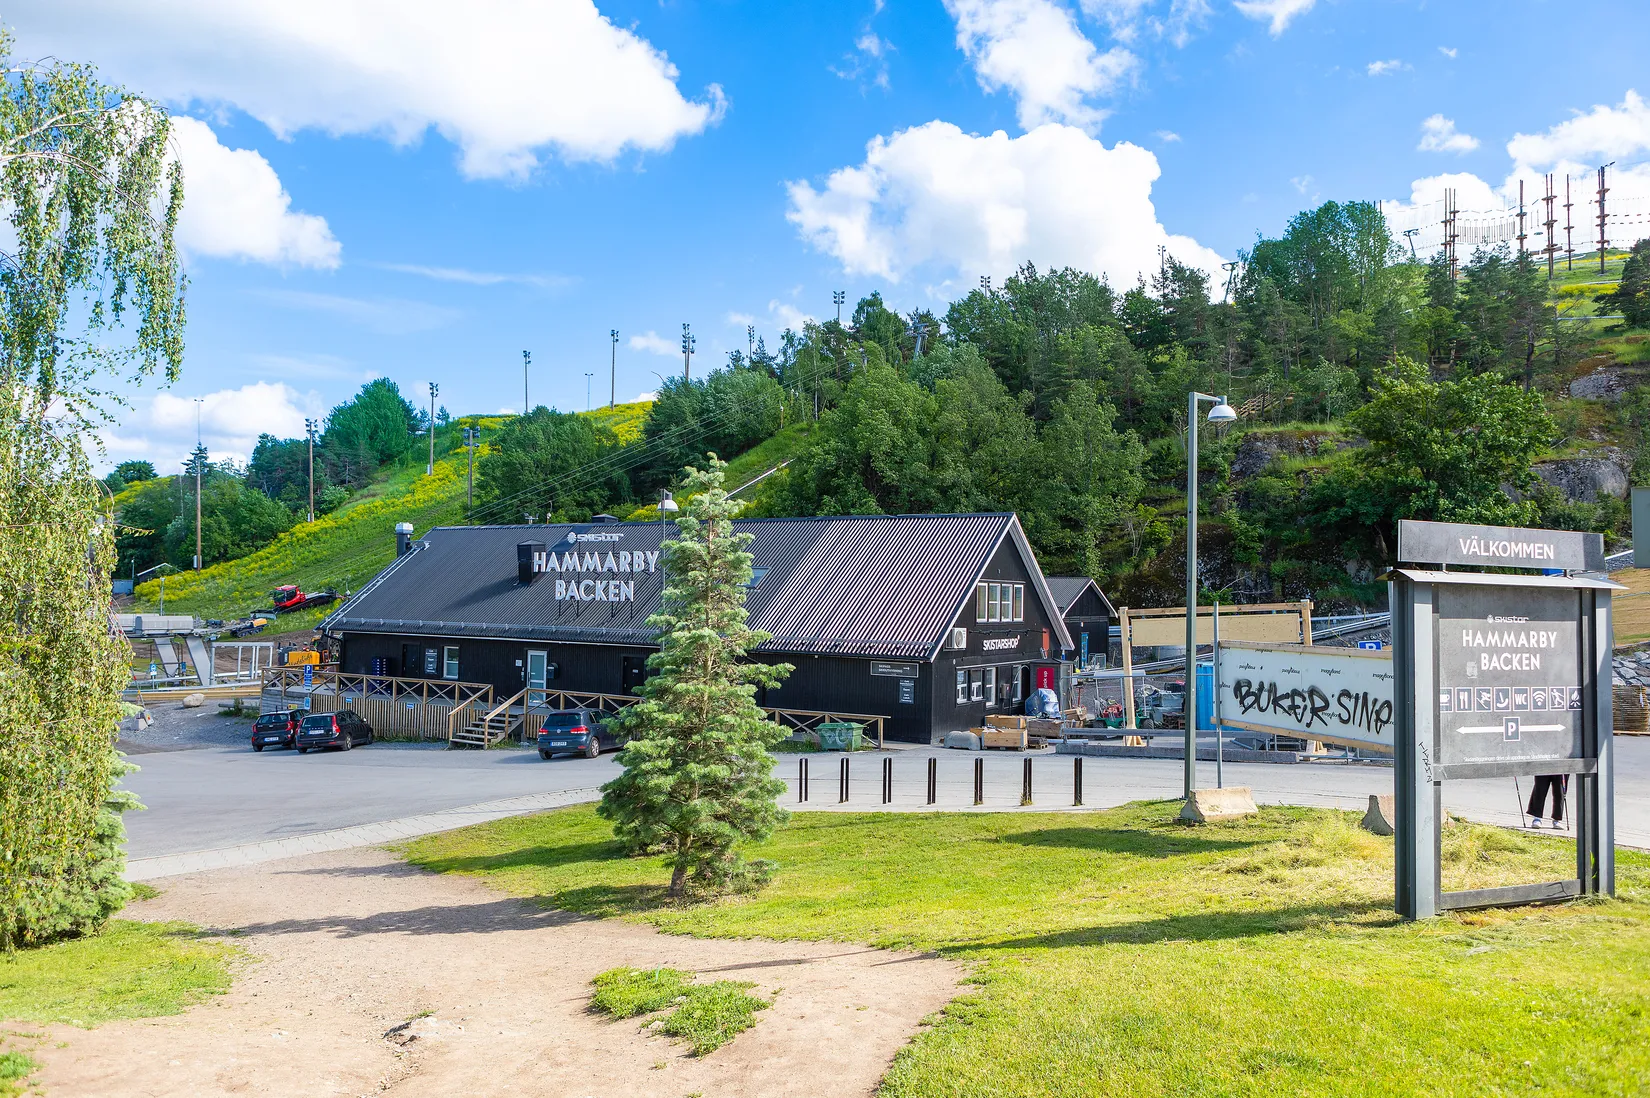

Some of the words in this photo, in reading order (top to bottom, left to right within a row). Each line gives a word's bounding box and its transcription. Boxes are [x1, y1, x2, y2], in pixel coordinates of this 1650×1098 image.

[1459, 536, 1554, 559] VÄLKOMMEN
[533, 551, 660, 572] HAMMARBY
[555, 579, 634, 601] BACKEN
[983, 637, 1019, 650] SKISTARSHOP
[1462, 630, 1557, 648] HAMMARBY
[1480, 653, 1540, 671] BACKEN
[1514, 693, 1527, 705] WC
[1507, 722, 1516, 736] P
